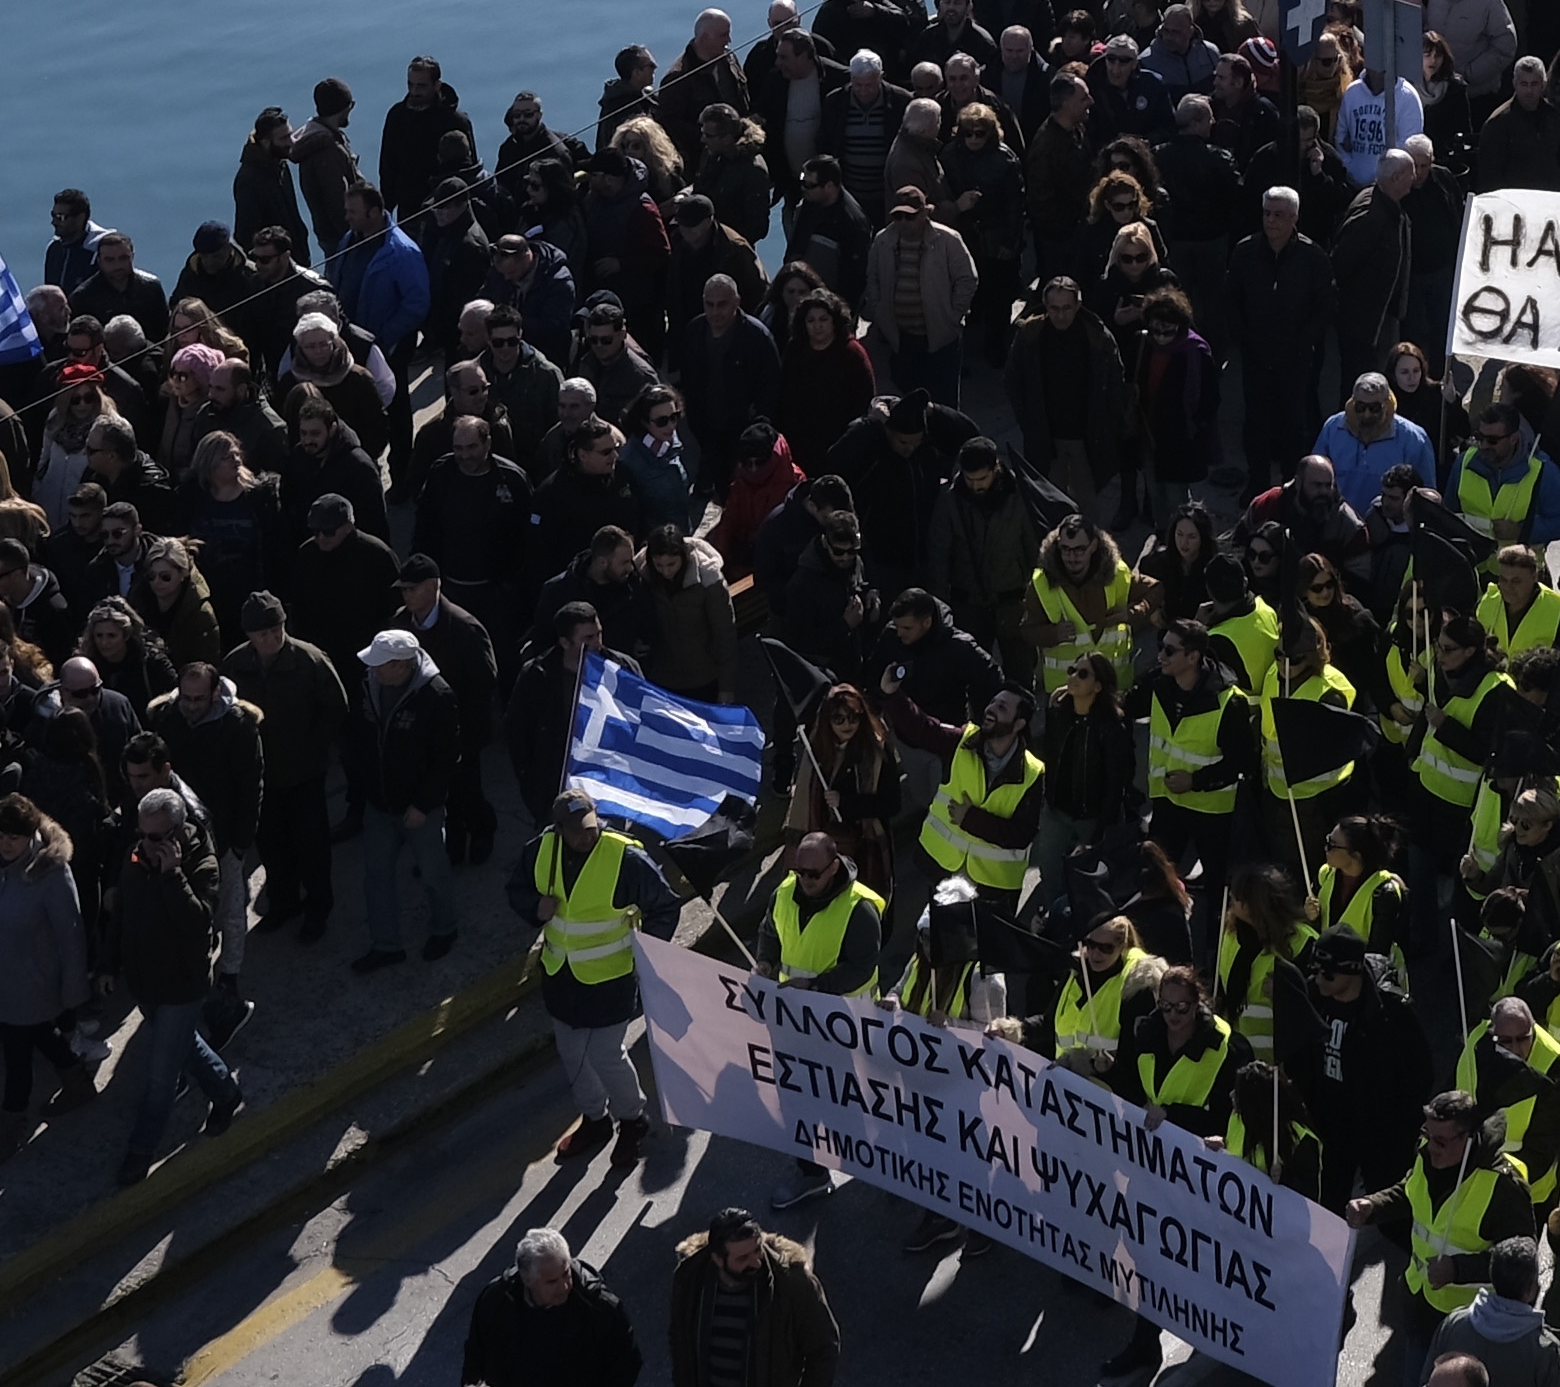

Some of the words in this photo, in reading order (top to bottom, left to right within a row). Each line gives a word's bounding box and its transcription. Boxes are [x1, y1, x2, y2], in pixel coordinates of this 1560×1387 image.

[1461, 285, 1541, 351] ΘΑ
[1479, 213, 1521, 273] Η
[718, 974, 951, 1075] ΣΥΛΛΟΓΟΣ
[957, 1044, 1274, 1239] ΚΑΤΑΣΤΗΜΑΤΩΝ
[747, 1042, 948, 1144] ΕΣΤΙΑΣΗΣ
[957, 1109, 1022, 1178] ΚΑΙ
[1030, 1145, 1277, 1312] ΨΥΧΑΓΩΓΙΑΣ
[794, 1118, 952, 1204] ΔΗΜΟΤΙΚΗΣ
[958, 1180, 1095, 1273] ΕΝΟΤΗΤΑΣ
[1099, 1250, 1246, 1357] ΜΥΤΙΛΗΝΗΣ
